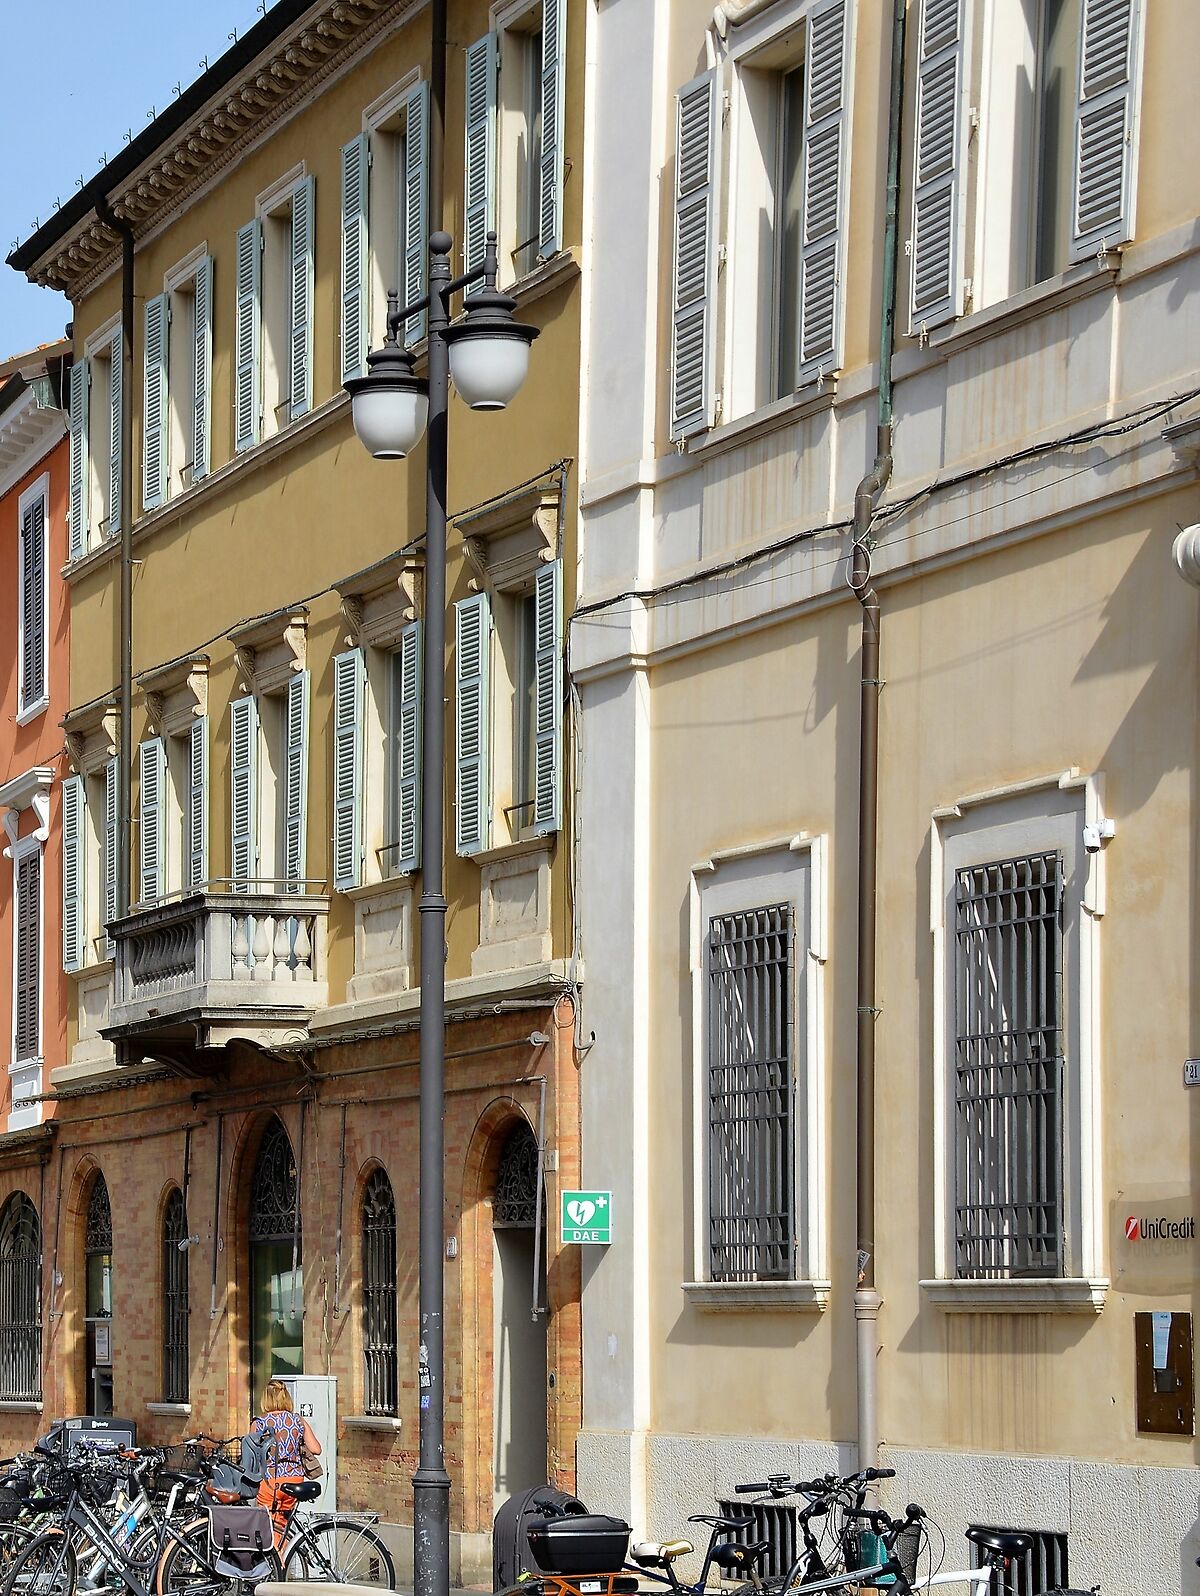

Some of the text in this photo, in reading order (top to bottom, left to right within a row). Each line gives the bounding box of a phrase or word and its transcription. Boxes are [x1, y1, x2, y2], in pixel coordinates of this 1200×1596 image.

[573, 1230, 600, 1241] DAE
[1140, 1216, 1195, 1239] UniCredit
[83, 1523, 126, 1573] BUGNO
